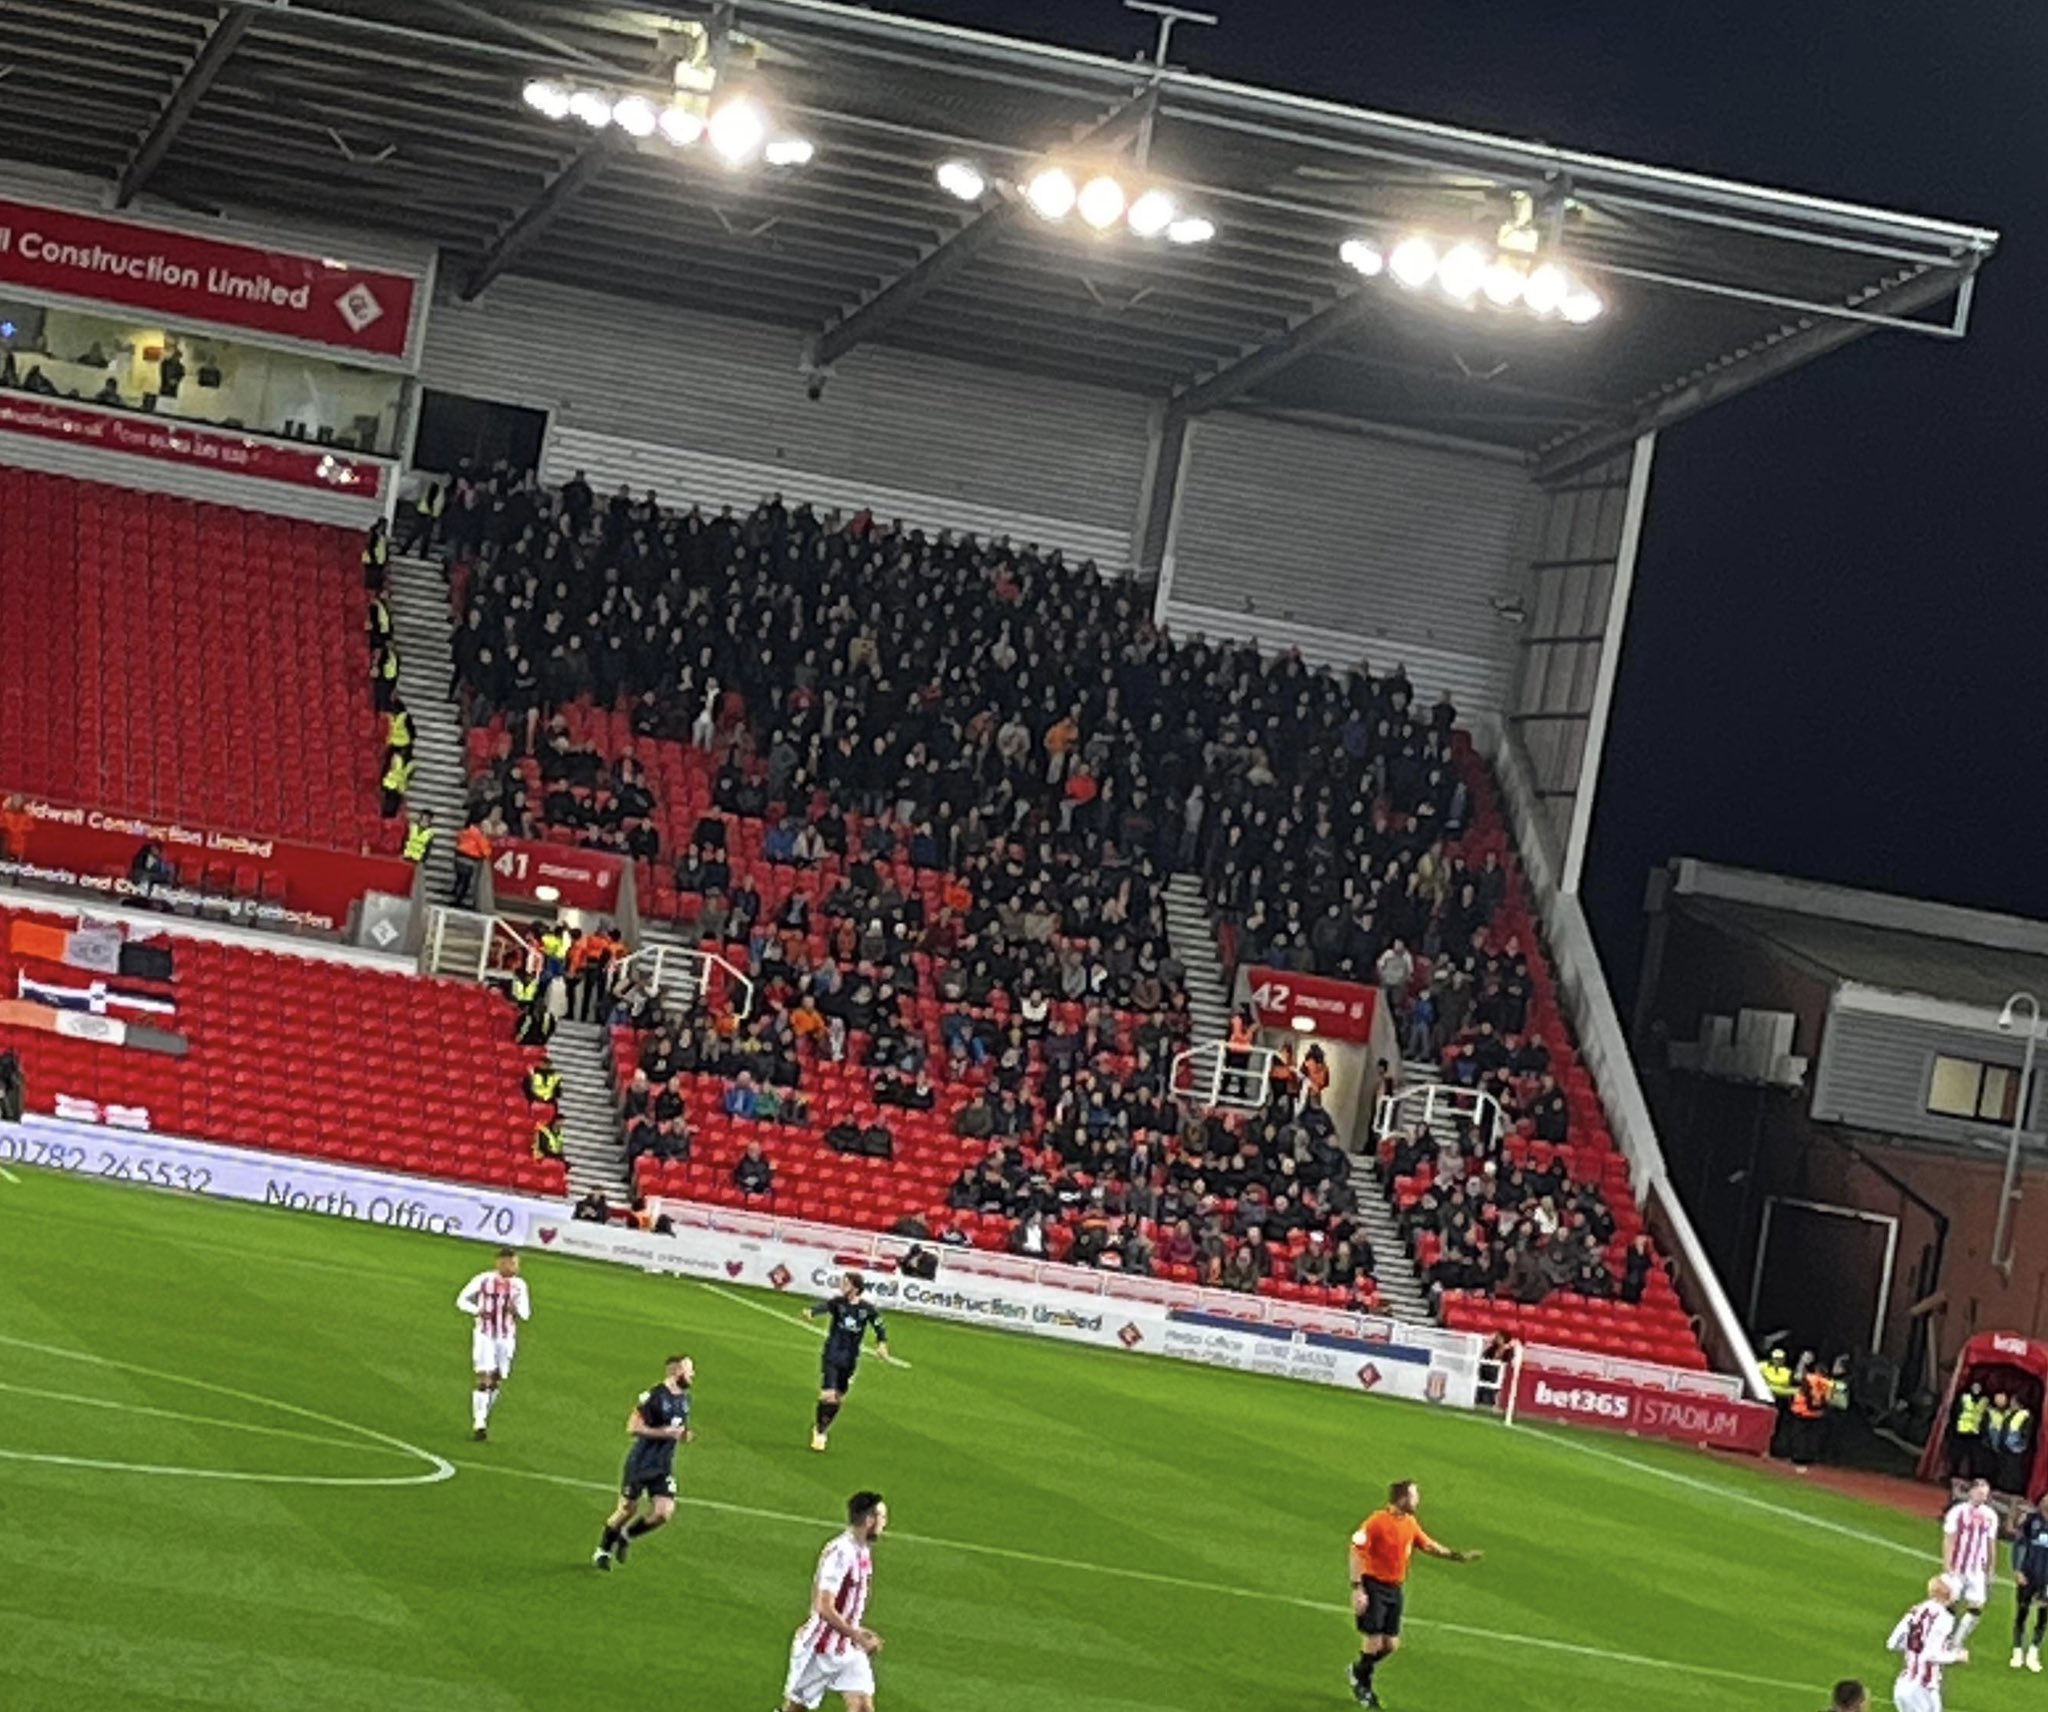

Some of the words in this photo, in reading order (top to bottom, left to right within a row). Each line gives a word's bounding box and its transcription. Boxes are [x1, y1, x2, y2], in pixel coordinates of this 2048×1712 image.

[18, 232, 199, 290] Construction
[207, 266, 311, 309] Limited
[494, 850, 529, 880] 41
[1252, 981, 1291, 1013] 42
[0, 1134, 86, 1171] 01782
[99, 1151, 212, 1192] 265532
[265, 1178, 357, 1218] North
[368, 1195, 463, 1235] Office
[811, 1268, 899, 1297] Cawell
[903, 1283, 1026, 1321] Construction
[1534, 1380, 1630, 1419] bet365
[1642, 1401, 1739, 1437] STADIUM
